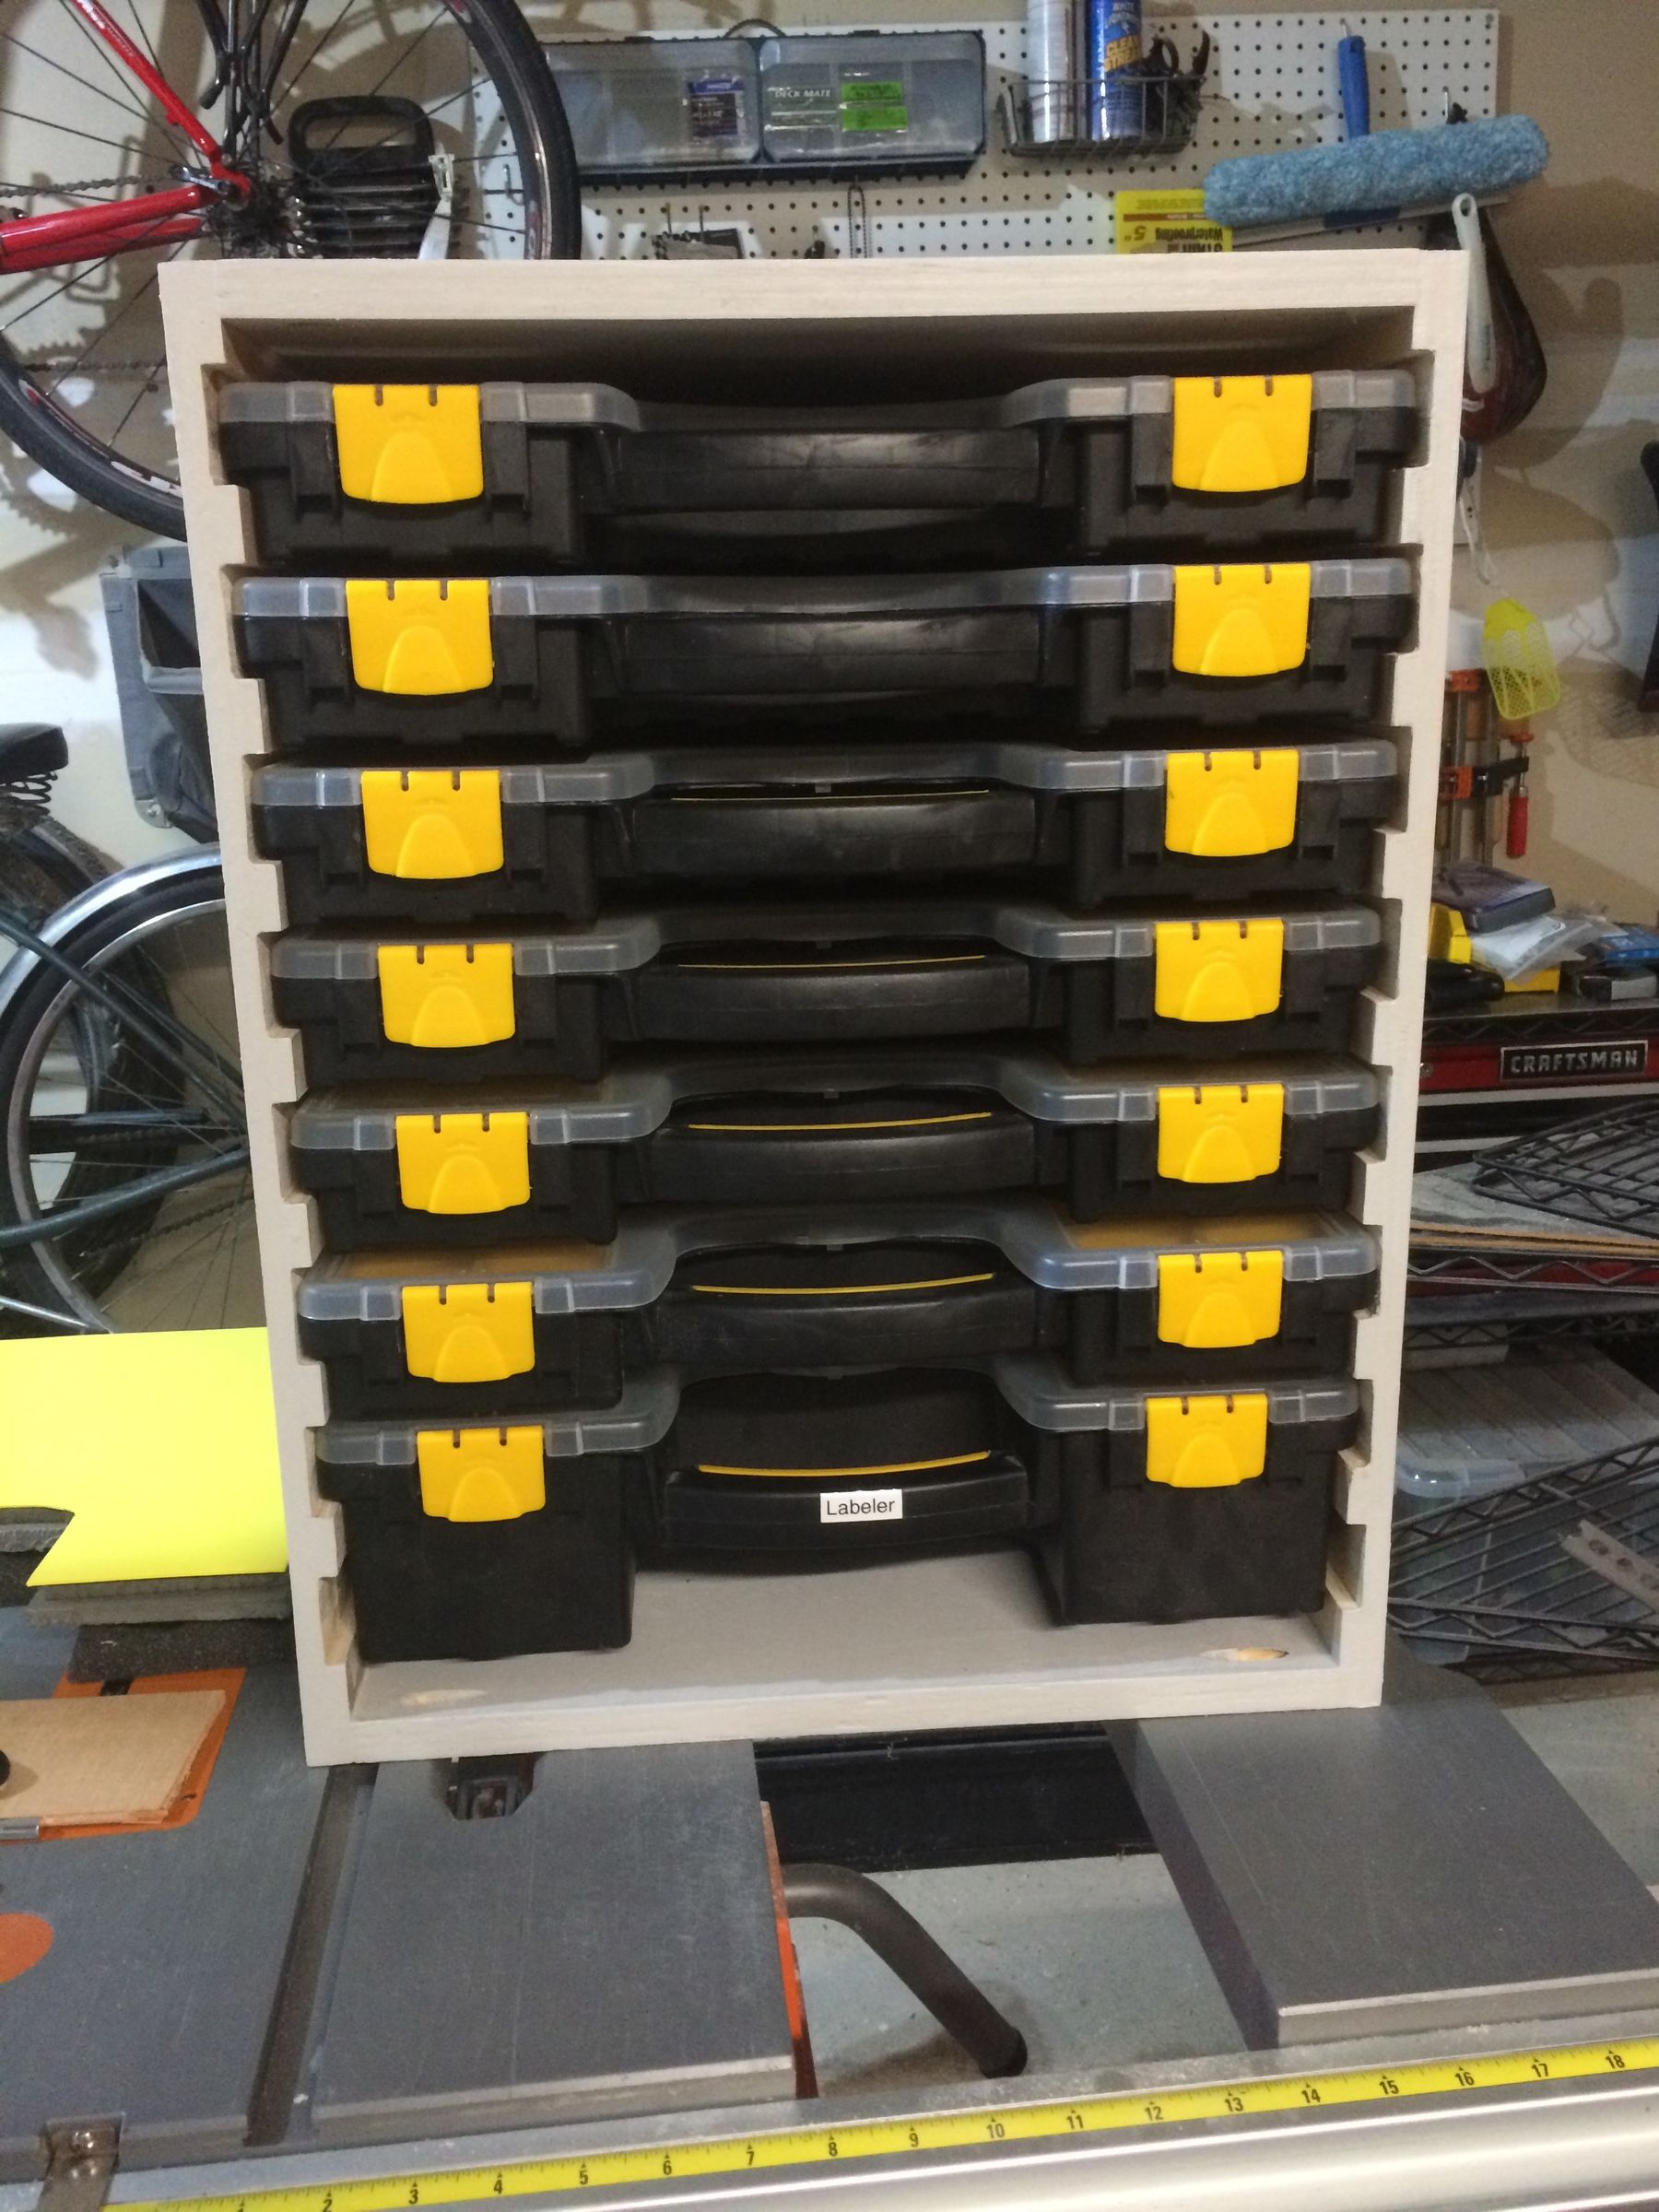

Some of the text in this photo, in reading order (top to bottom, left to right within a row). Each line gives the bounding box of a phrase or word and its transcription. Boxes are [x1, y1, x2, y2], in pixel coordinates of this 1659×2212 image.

[804, 88, 830, 98] MATE
[1511, 1049, 1638, 1074] CRAFTSMAN
[827, 1498, 895, 1516] Labeler
[408, 2189, 418, 2204] 3
[493, 2179, 503, 2194] 4
[579, 2170, 589, 2184] 5
[663, 2159, 672, 2175] 6
[746, 2150, 755, 2165] 7
[828, 2142, 838, 2157] 8
[909, 2133, 919, 2147] 9
[986, 2124, 1005, 2138] 10
[1066, 2114, 1084, 2129] 11
[1144, 2106, 1163, 2121] 12
[1224, 2097, 1243, 2112] 13
[1301, 2088, 1321, 2103] 14
[1379, 2079, 1399, 2095] 15
[1454, 2071, 1475, 2086] 16
[1531, 2063, 1548, 2077] 17
[1606, 2054, 1625, 2069] 18
